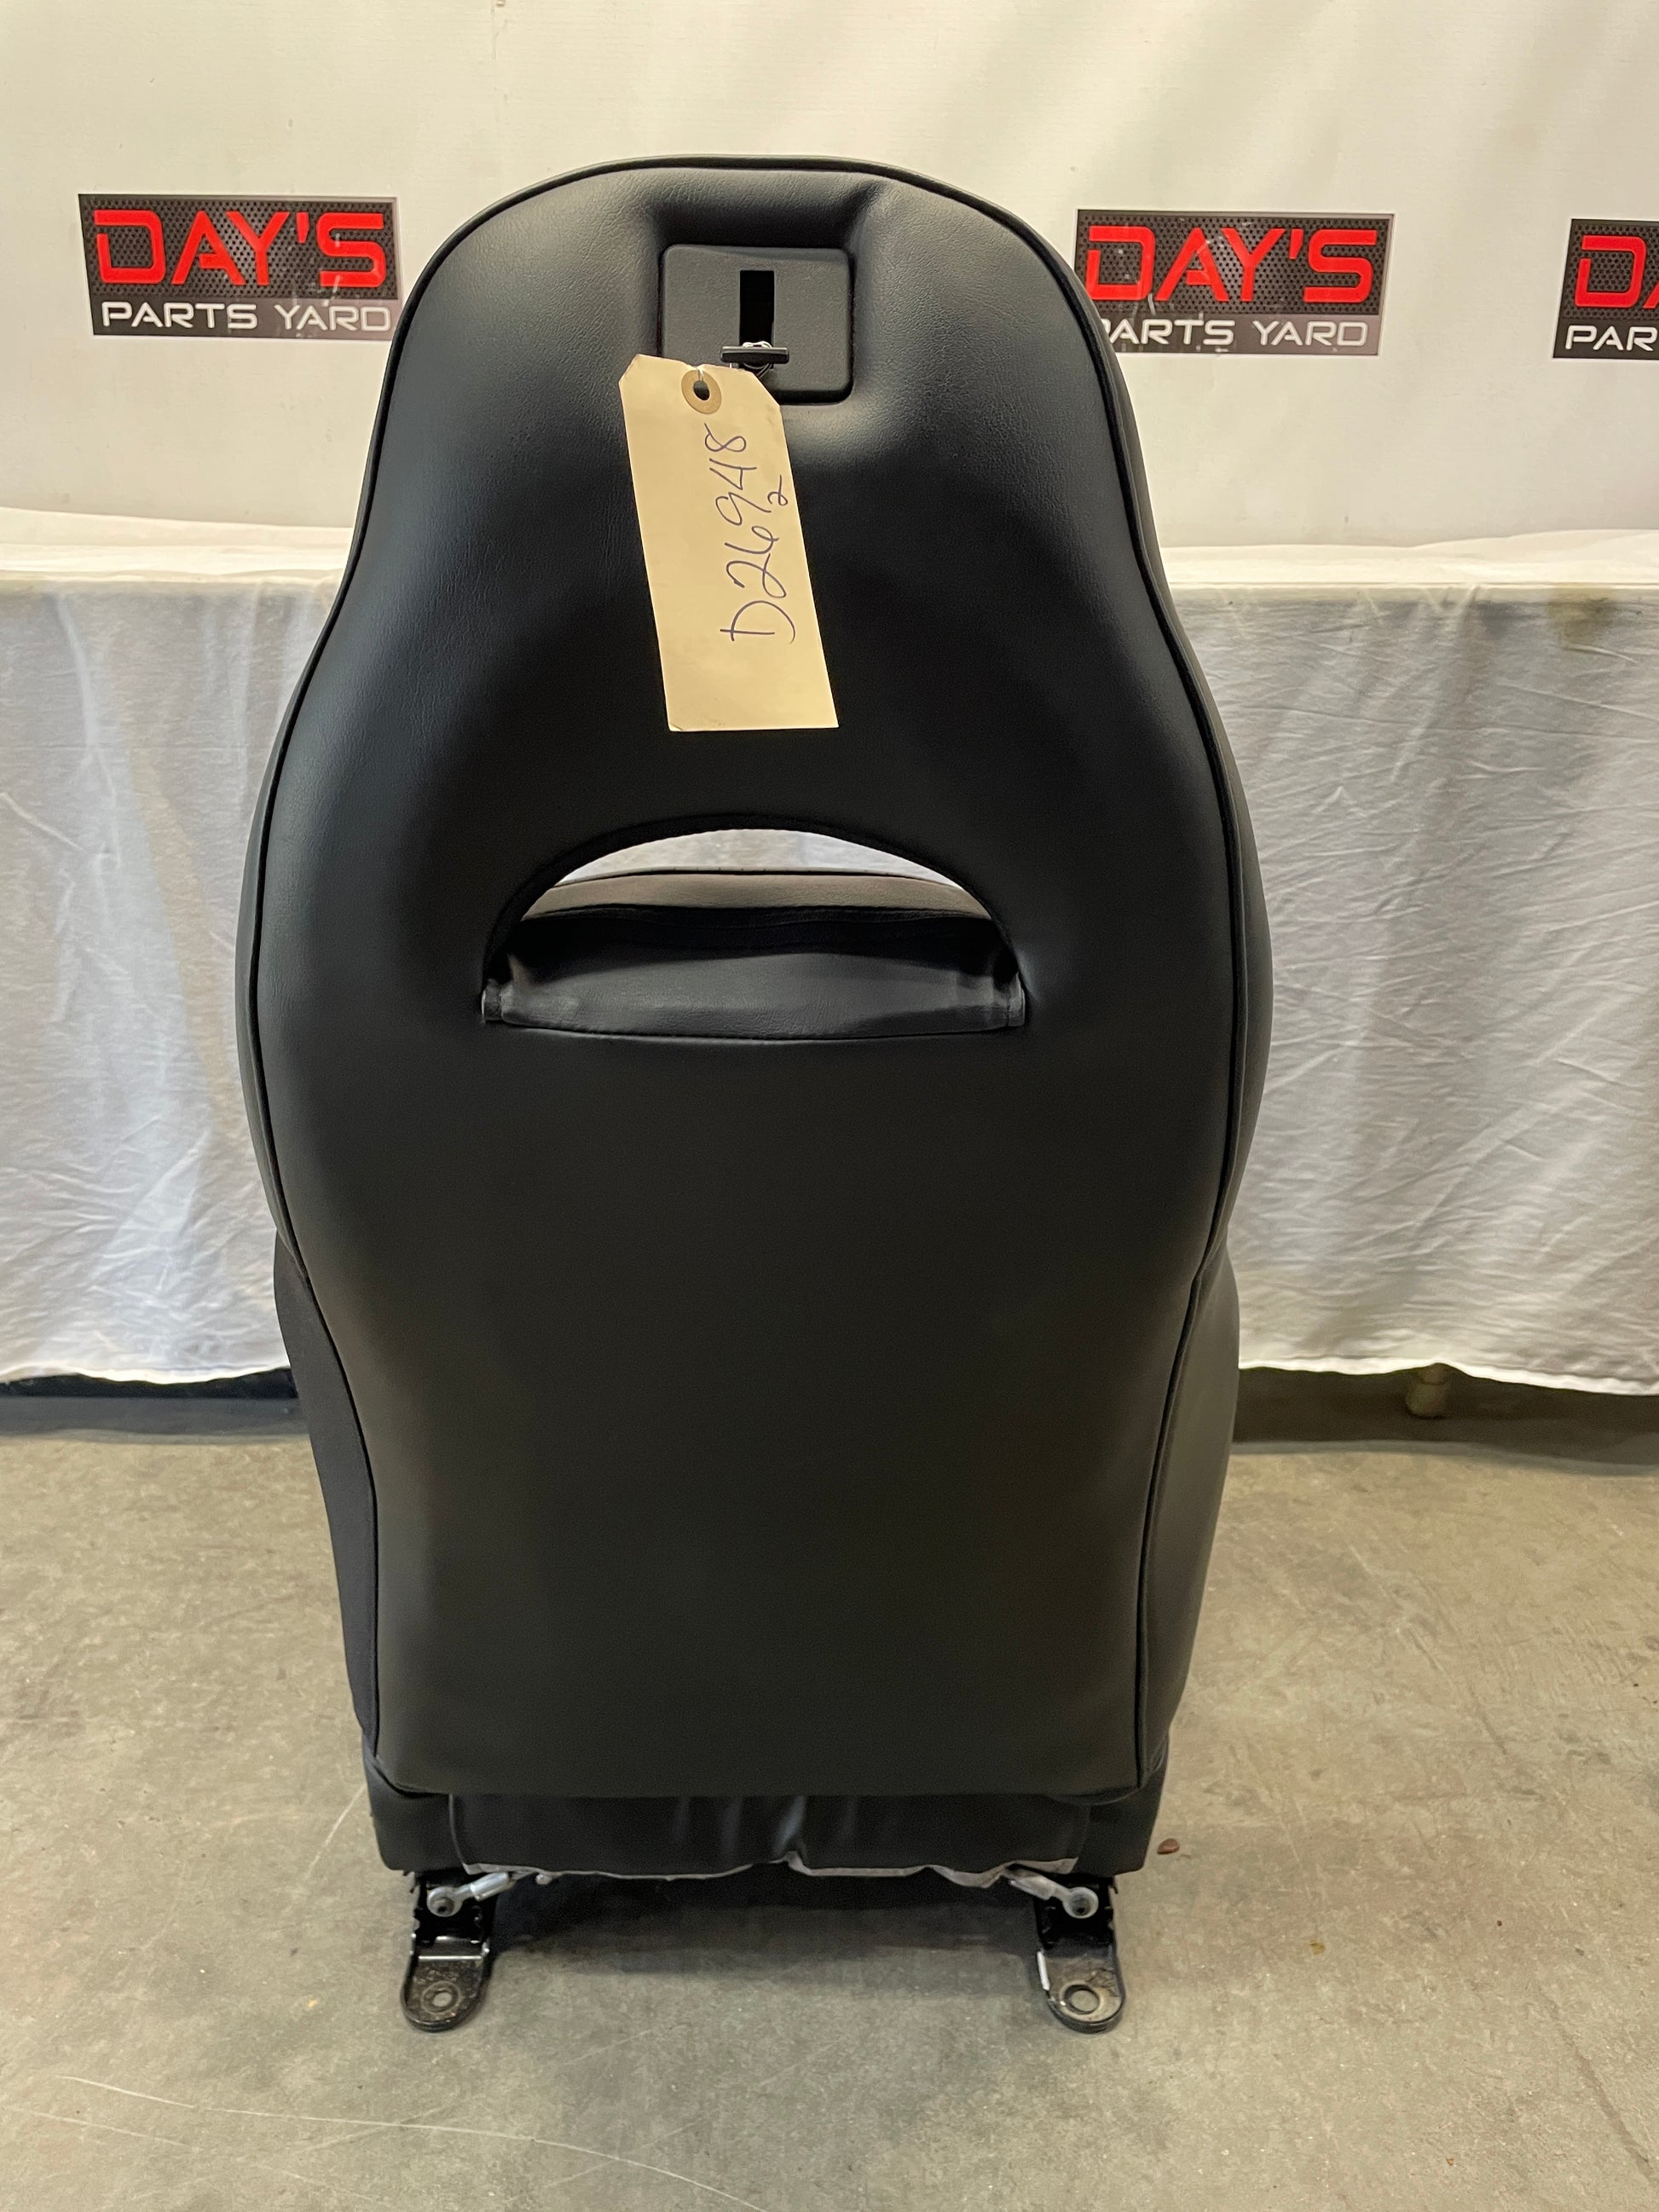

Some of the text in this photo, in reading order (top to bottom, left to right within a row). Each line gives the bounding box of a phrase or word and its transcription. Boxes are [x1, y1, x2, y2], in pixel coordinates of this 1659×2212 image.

[93, 209, 387, 288] DAY'S
[1085, 225, 1378, 303] DAY'S
[1574, 234, 1659, 309] D
[101, 301, 391, 332] PARTS YARD
[1251, 320, 1368, 346] YARD
[1565, 325, 1658, 351] PAR
[704, 423, 796, 644] D26948
